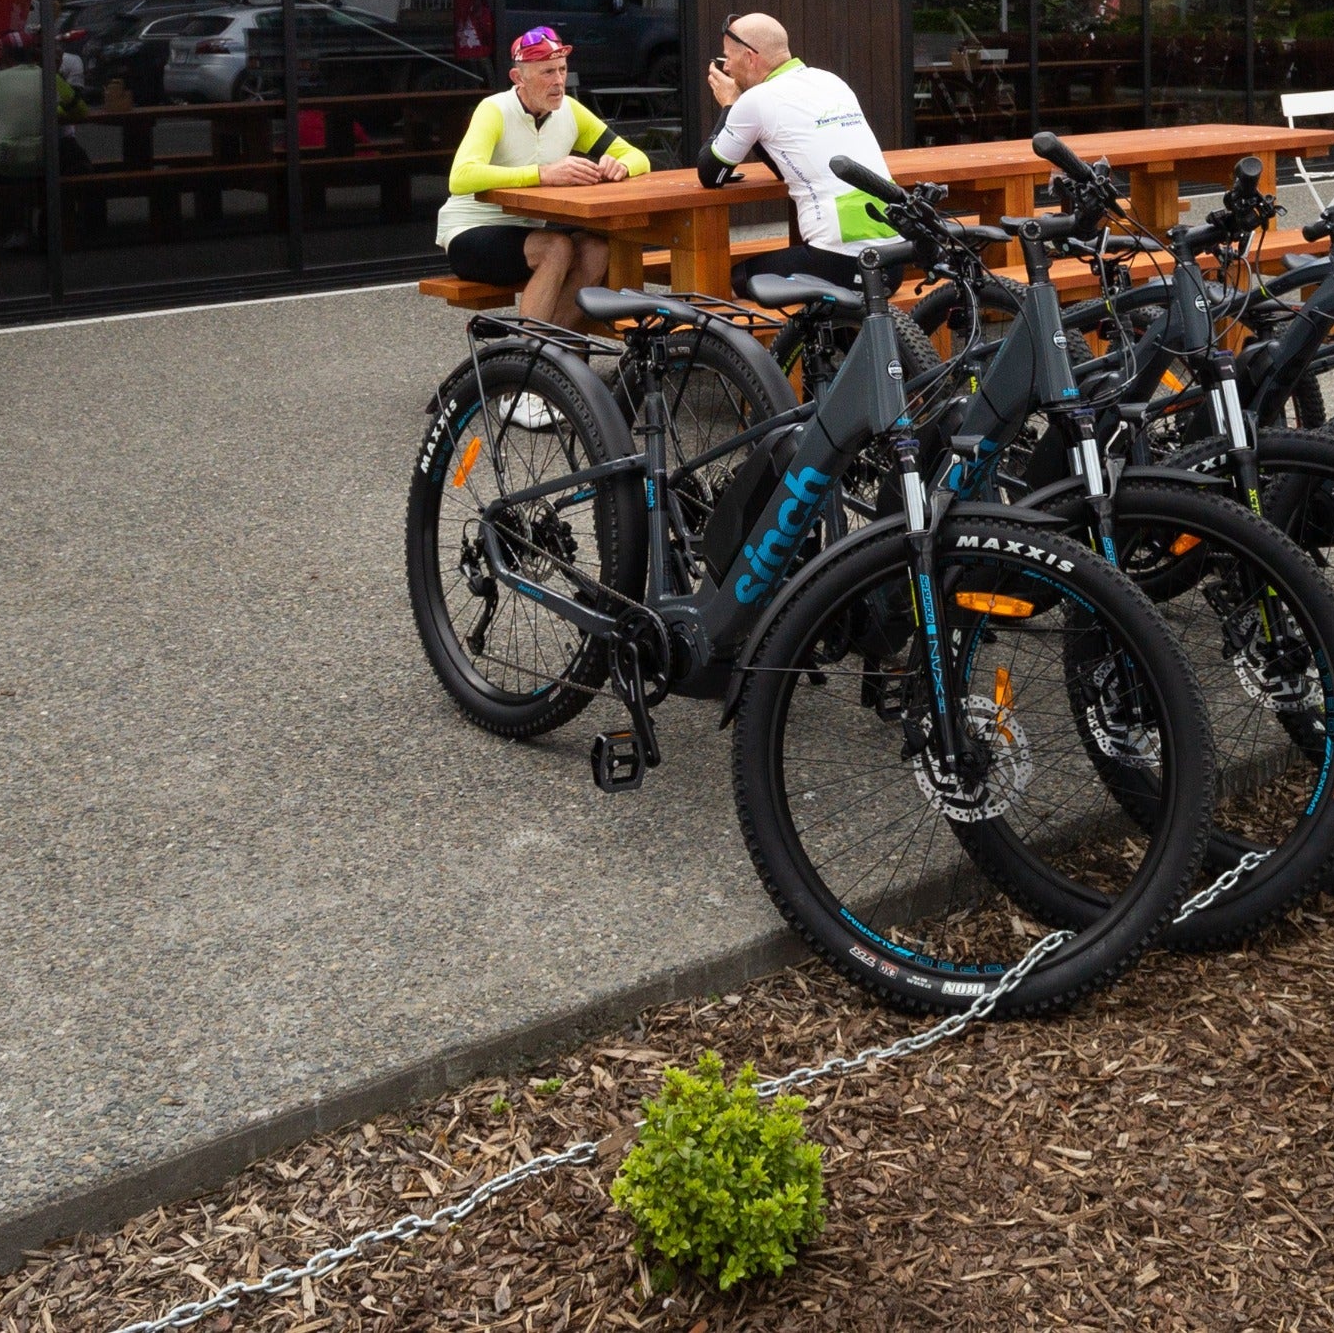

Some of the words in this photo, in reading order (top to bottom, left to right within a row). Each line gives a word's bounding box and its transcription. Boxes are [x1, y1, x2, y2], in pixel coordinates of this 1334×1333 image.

[420, 398, 458, 475] MAXXIS
[646, 478, 656, 510] sinch
[735, 466, 833, 605] sinch
[956, 535, 1076, 574] MAXXIS
[1040, 576, 1096, 615] ALEXRIMS
[1306, 758, 1332, 817] ALEXRIMS
[839, 906, 895, 950] ALEXRIMS
[941, 980, 987, 997] IKON
